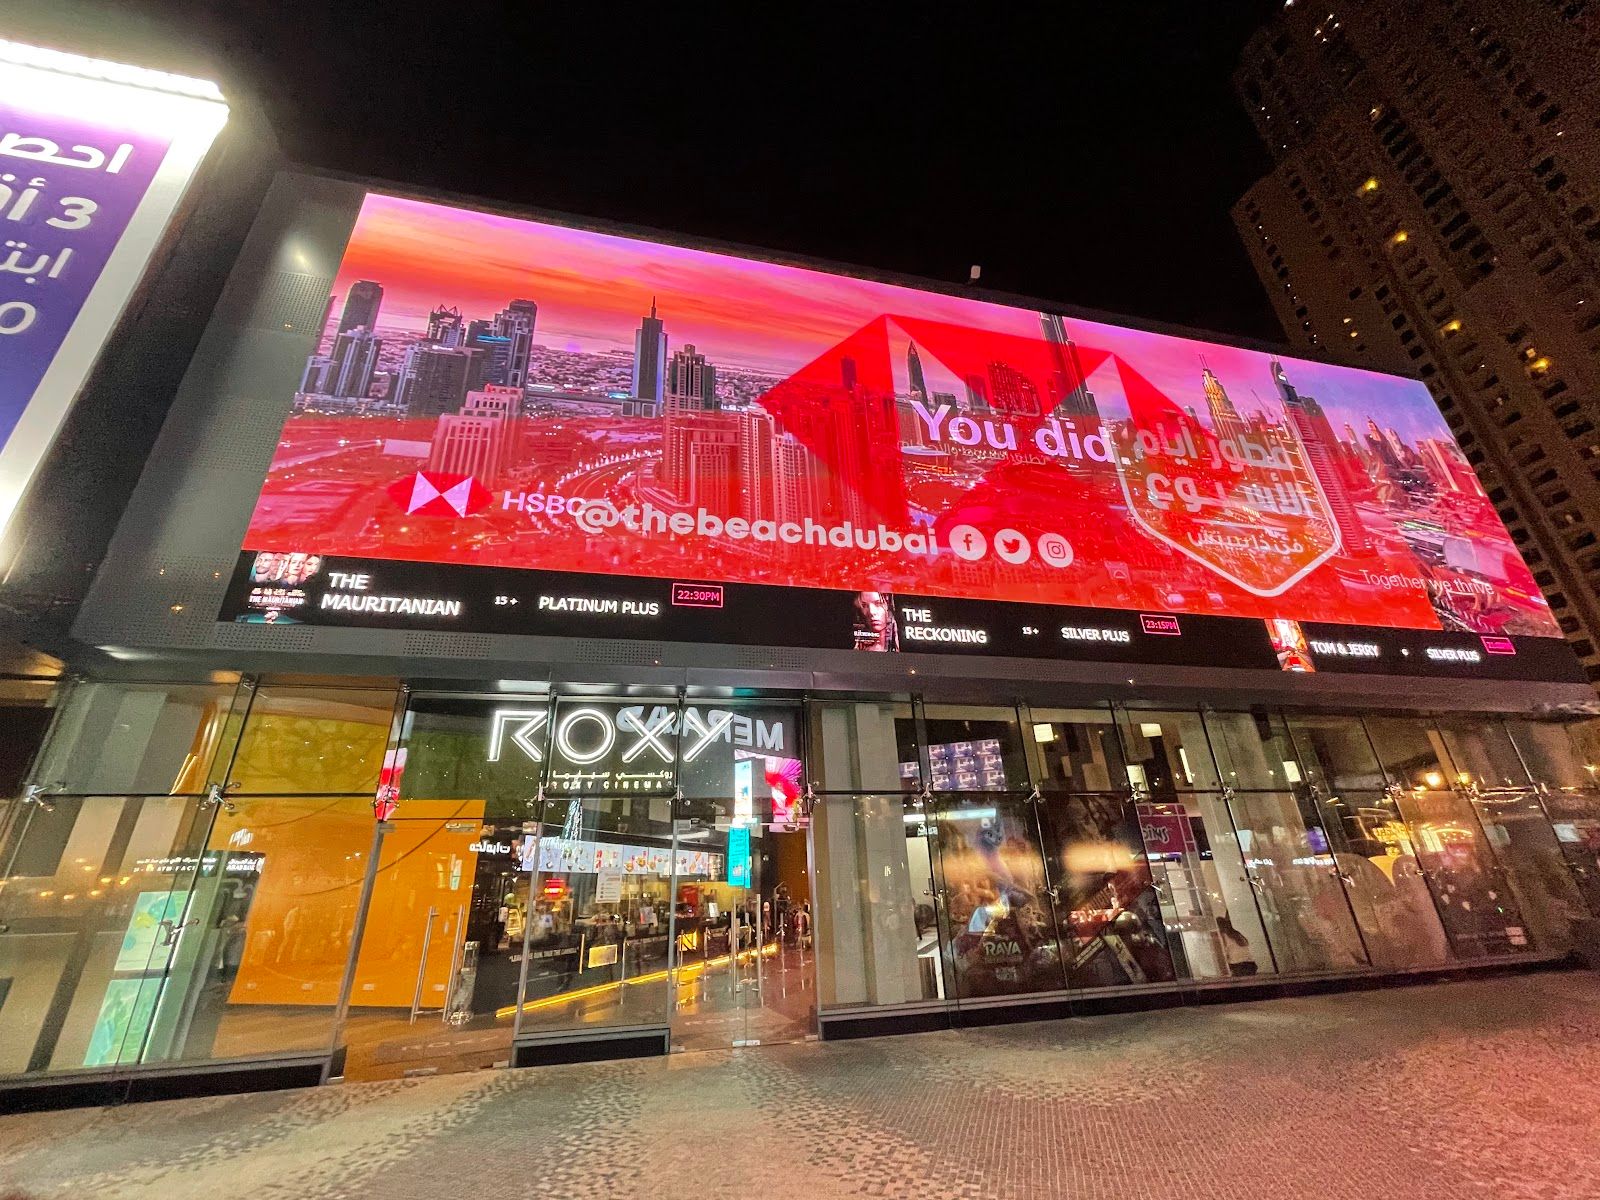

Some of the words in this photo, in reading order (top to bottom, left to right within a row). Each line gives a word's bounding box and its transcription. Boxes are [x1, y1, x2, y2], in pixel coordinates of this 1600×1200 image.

[46, 196, 98, 230] 3
[910, 400, 1017, 451] You
[1132, 416, 1198, 466] أيام
[502, 490, 587, 517] HSBC
[575, 498, 938, 557] @thebeachdubai
[328, 572, 371, 590] THE
[1359, 568, 1426, 590] Together
[1429, 579, 1453, 591] we
[1454, 577, 1495, 596] thrive
[320, 593, 461, 616] MAURITANIAN
[538, 596, 618, 613] PLATINUM
[622, 600, 660, 616] PLUS
[676, 590, 720, 603] 22:30PM
[902, 607, 932, 623] THE
[1060, 627, 1101, 641] SILVER
[1102, 629, 1131, 643] PLUS
[1145, 619, 1178, 632] 23:15PM
[904, 626, 988, 645] RECKONING
[1310, 641, 1336, 655] TOM
[1337, 642, 1349, 656] &
[1349, 643, 1379, 658] JERRY
[1426, 648, 1455, 661] SILVER
[1455, 650, 1481, 662] PLUS
[486, 708, 735, 765] ROXY
[615, 769, 673, 780] روكسي
[983, 941, 1022, 956] RAYA
